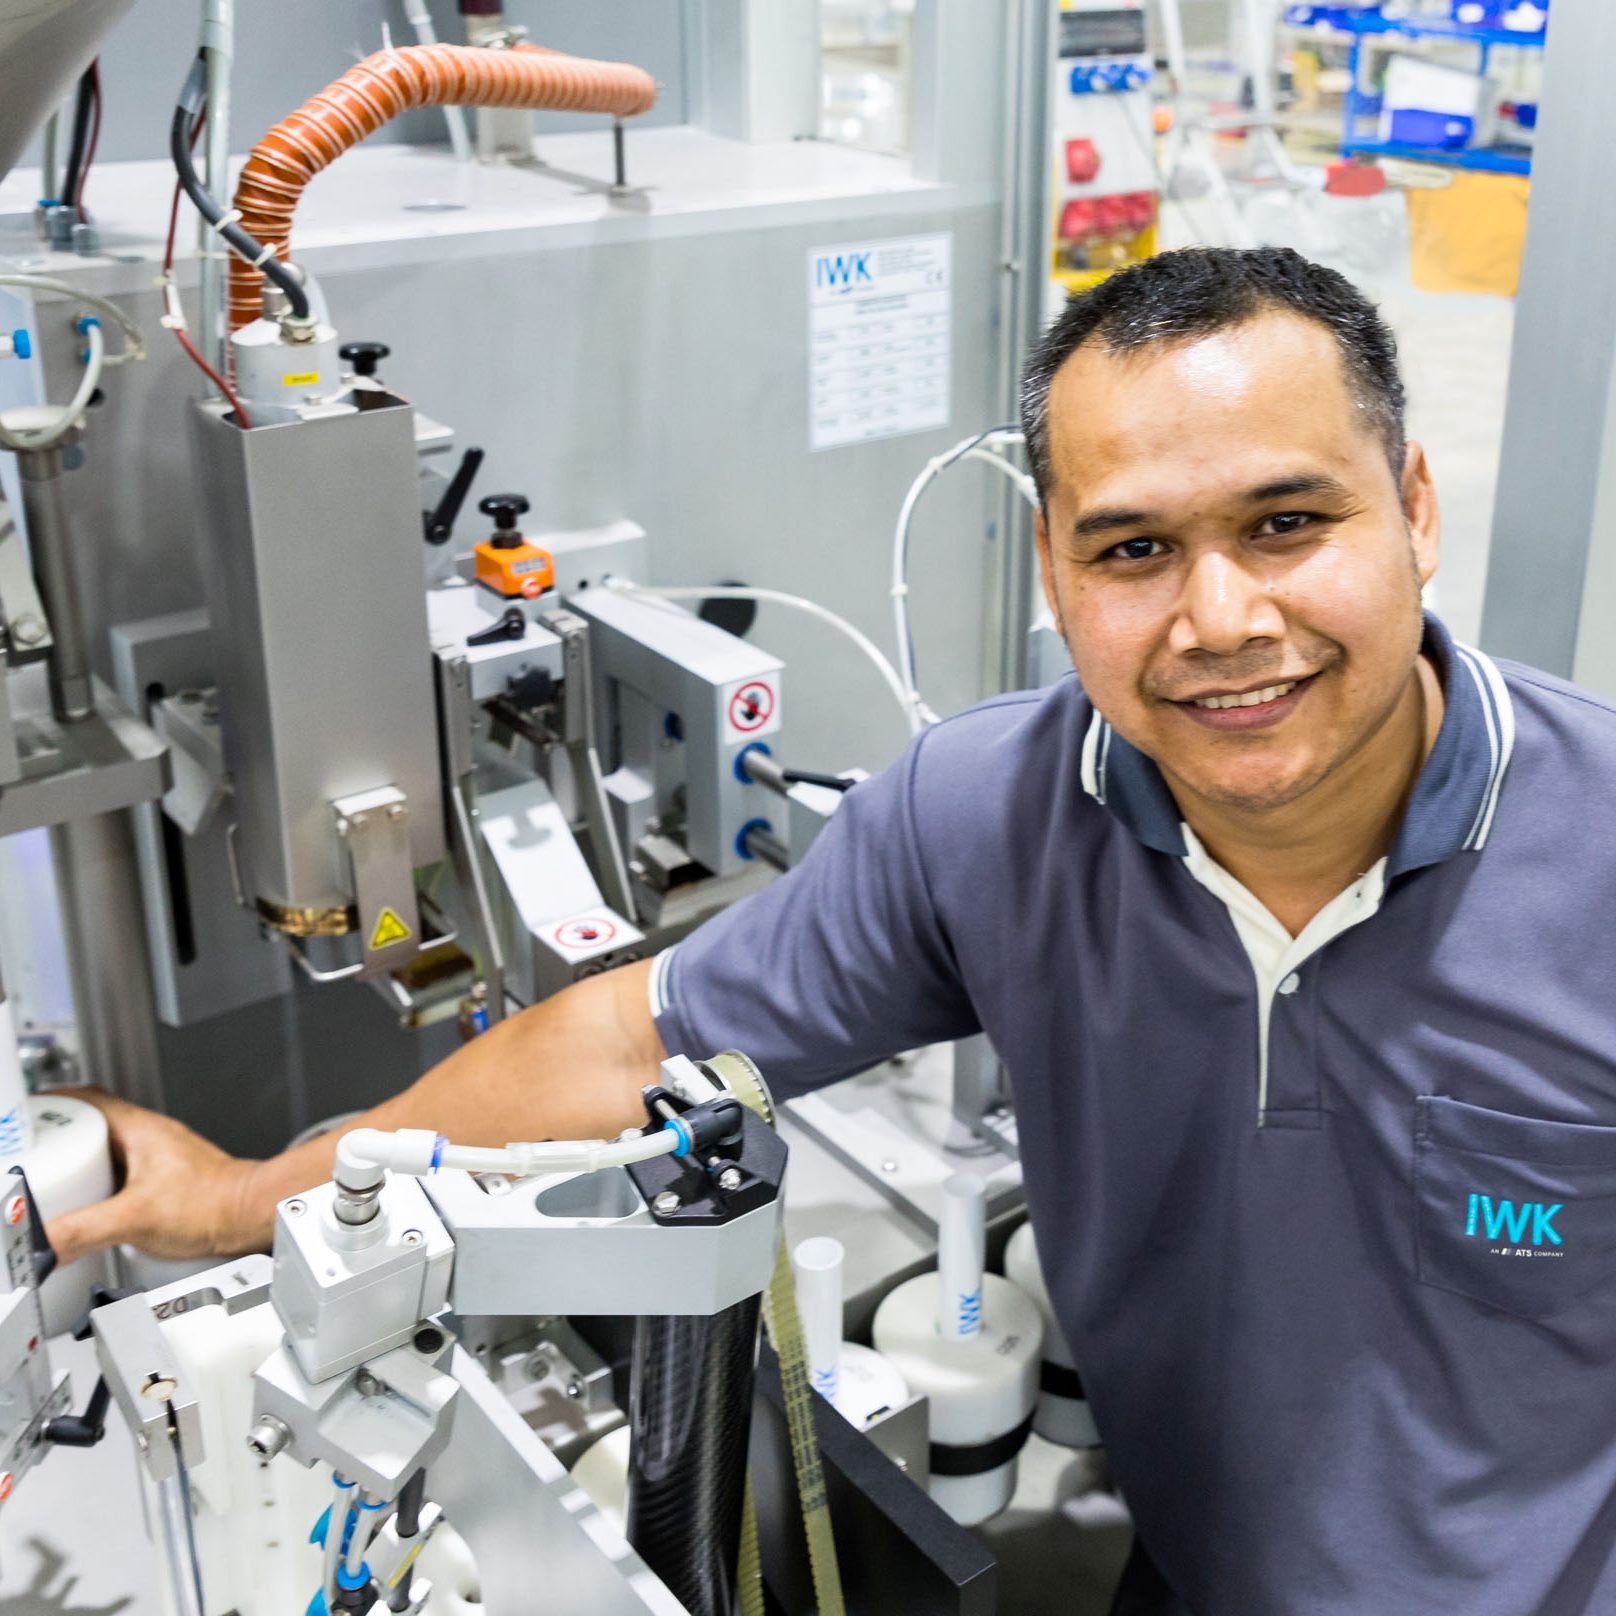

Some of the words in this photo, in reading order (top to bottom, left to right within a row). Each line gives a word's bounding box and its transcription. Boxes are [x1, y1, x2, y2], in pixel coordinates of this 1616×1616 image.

[817, 251, 872, 287] IWK
[1464, 1193, 1565, 1246] IWK
[1515, 1248, 1532, 1257] ATS
[152, 1297, 187, 1319] D2
[959, 1288, 980, 1335] IWK
